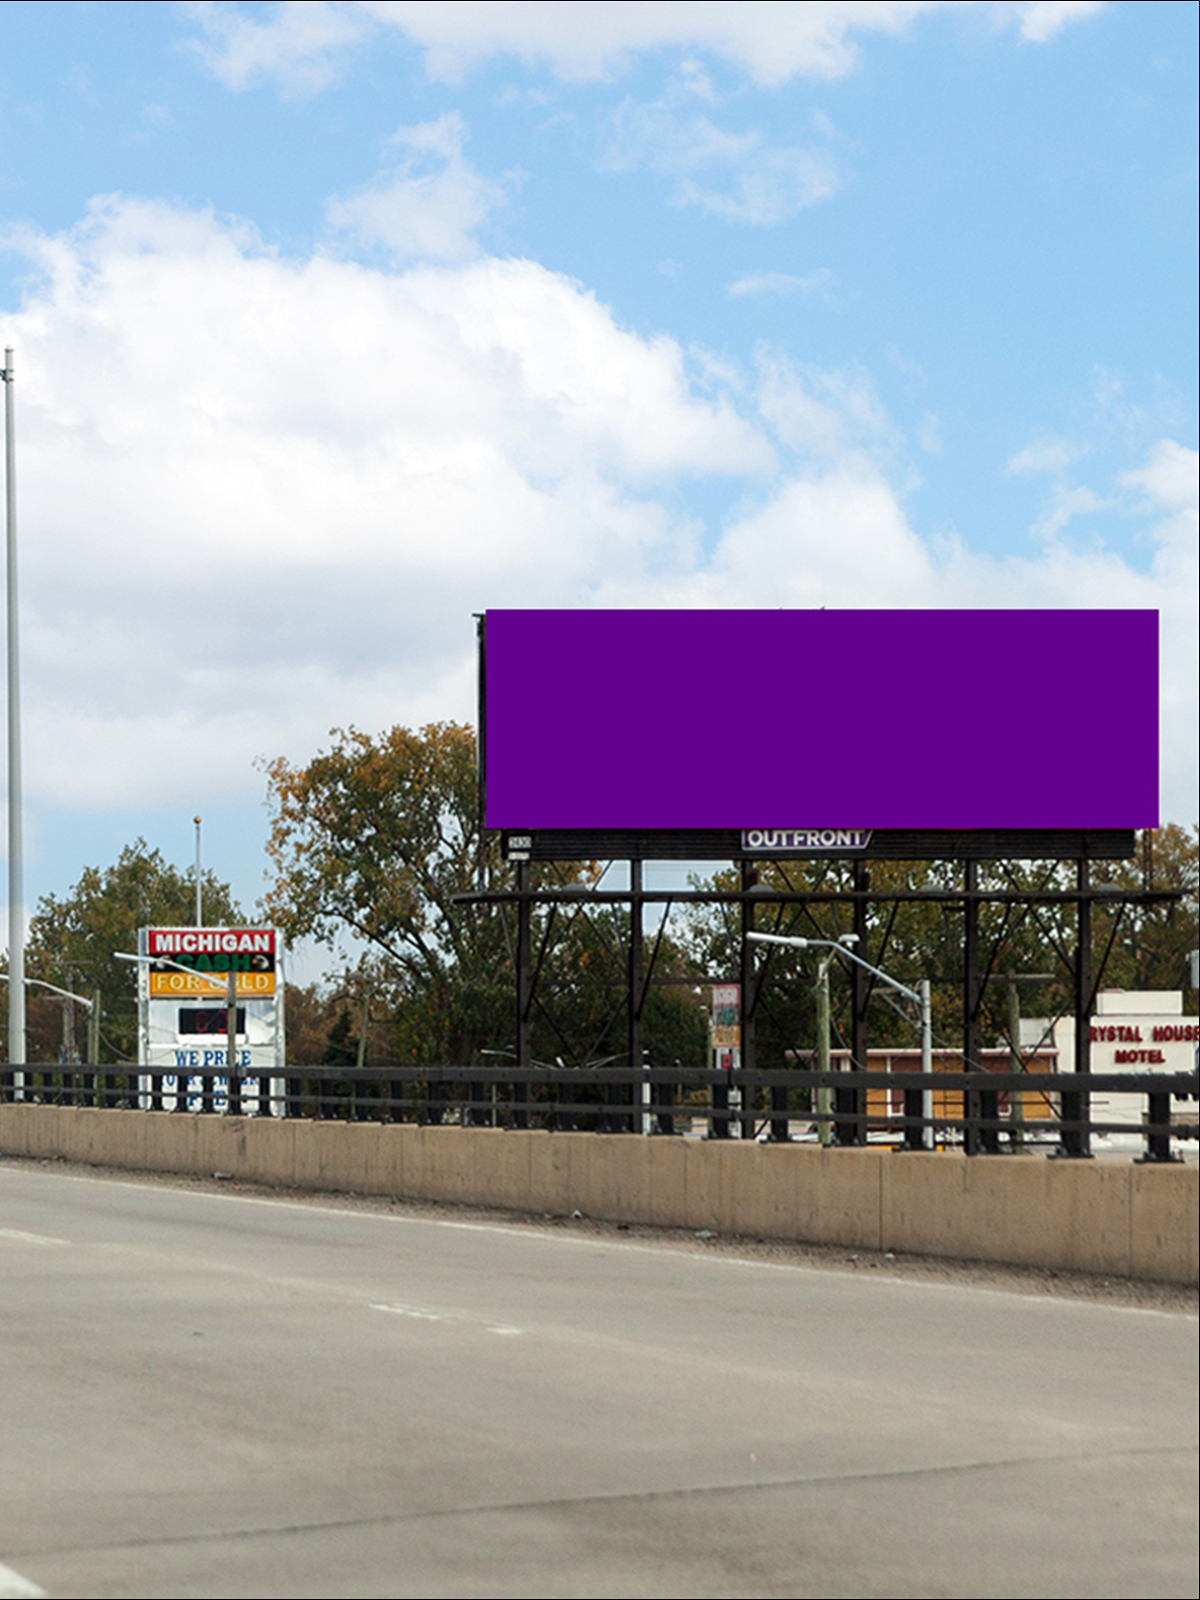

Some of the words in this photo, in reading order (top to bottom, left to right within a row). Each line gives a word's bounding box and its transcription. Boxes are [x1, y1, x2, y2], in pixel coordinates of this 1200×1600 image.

[748, 830, 864, 846] OUTFRONT
[156, 934, 270, 951] MICHIGAN
[176, 954, 250, 971] CASH
[157, 974, 200, 990] FOR
[1090, 1026, 1143, 1042] RYSTAL
[175, 1050, 199, 1066] WE
[1115, 1050, 1166, 1063] MOTEL
